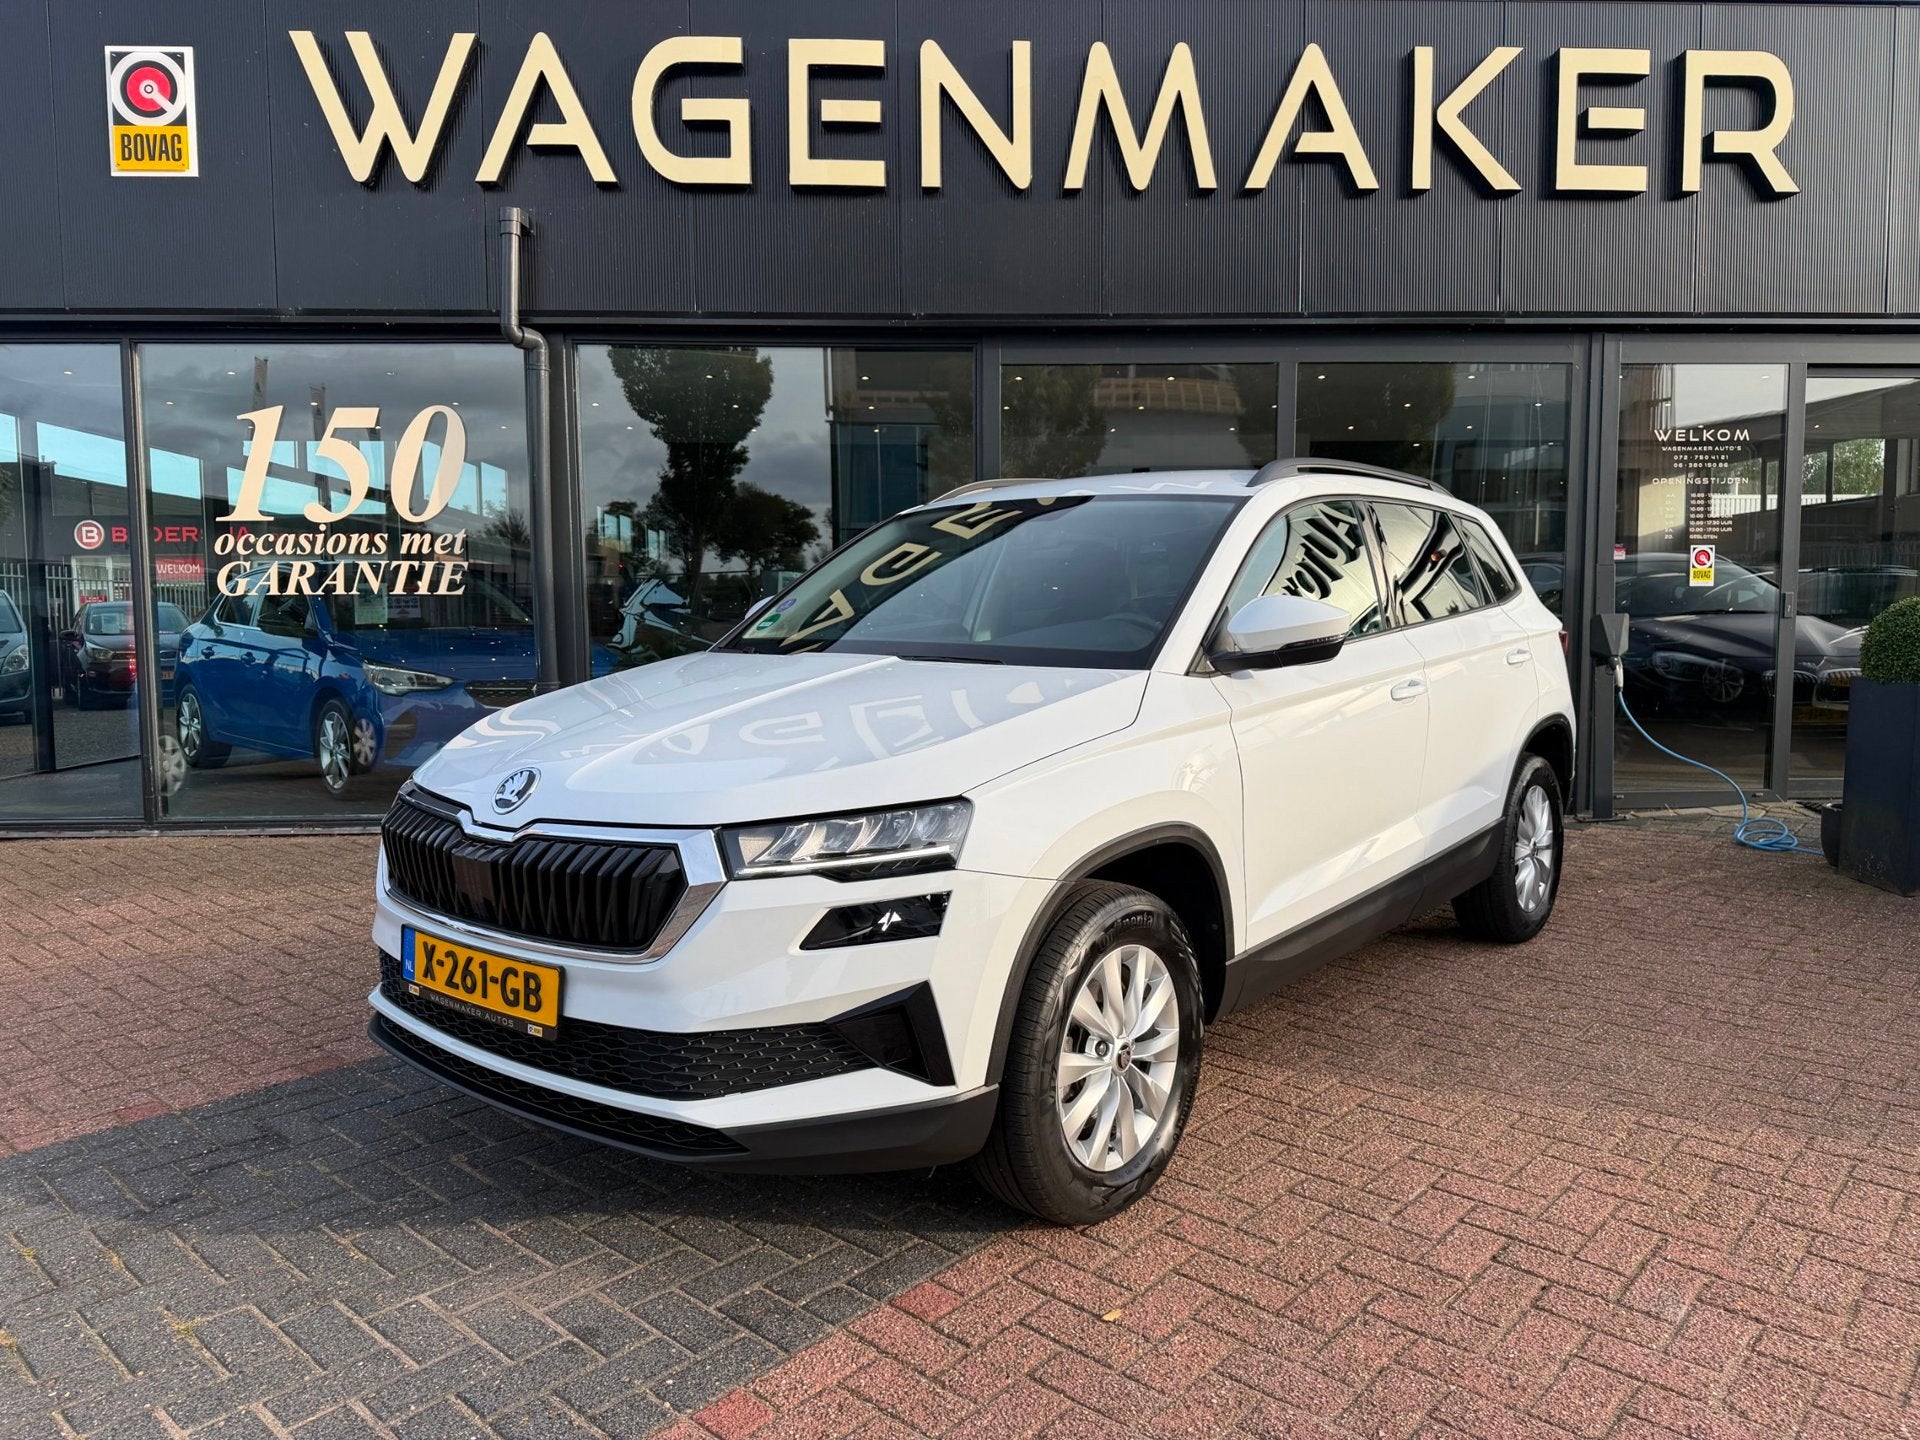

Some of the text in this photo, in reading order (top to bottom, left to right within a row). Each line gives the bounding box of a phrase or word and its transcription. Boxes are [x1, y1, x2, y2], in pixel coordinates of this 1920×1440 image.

[288, 30, 1799, 194] WAGENMAKER
[121, 133, 183, 162] BOVAG
[1654, 429, 1750, 442] WELKOM
[215, 405, 467, 523] 150
[1652, 477, 1749, 485] OPENINGSTIJDEN
[214, 523, 389, 555] occasions
[400, 528, 467, 555] met
[156, 562, 200, 575] WELKOM
[216, 560, 469, 597] GARANTIE
[1692, 569, 1711, 580] BOVAG
[405, 959, 414, 972] NL
[422, 941, 543, 1013] X-261-GB
[429, 993, 515, 1028] WAGENMAKER AUTOS
